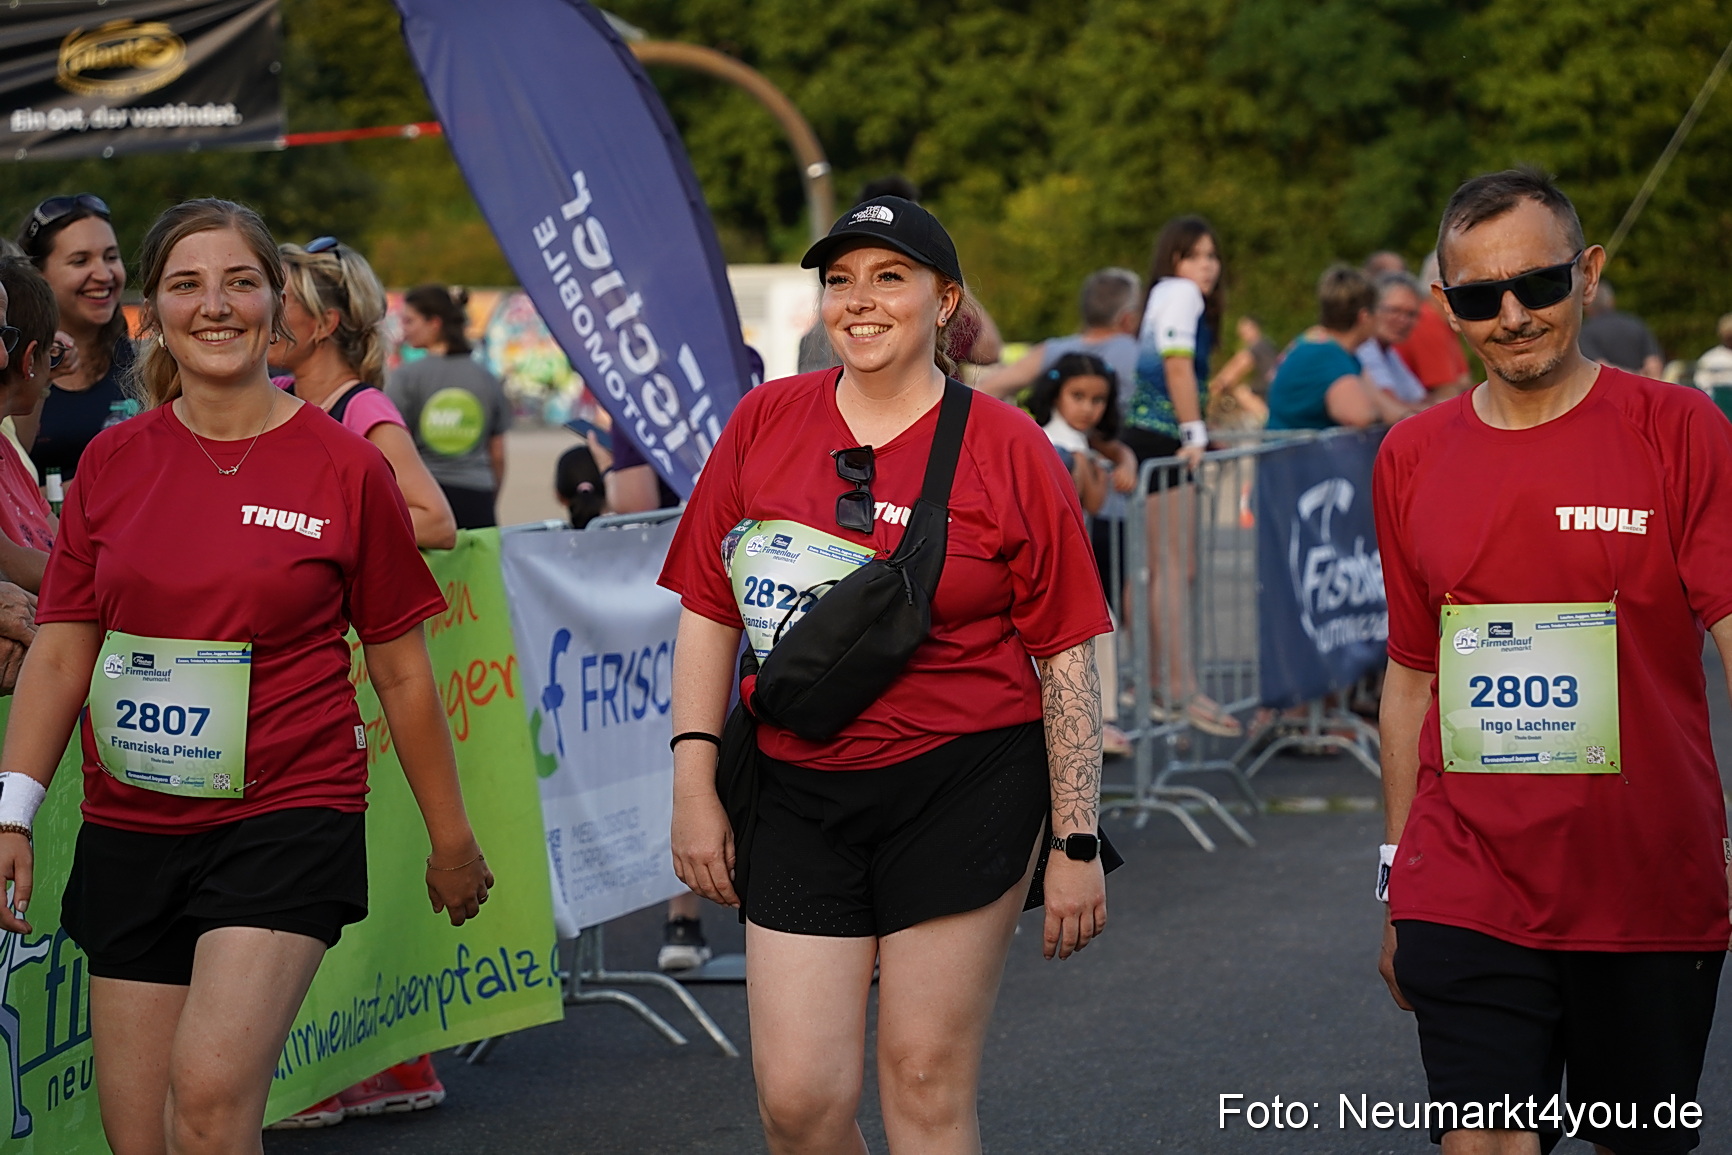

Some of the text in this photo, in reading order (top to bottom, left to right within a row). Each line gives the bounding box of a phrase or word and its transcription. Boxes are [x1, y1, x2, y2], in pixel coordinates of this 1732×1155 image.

[762, 546, 801, 559] Firmenlauf
[743, 576, 819, 613] 2822
[1481, 636, 1533, 647] Firmenlauf
[125, 667, 172, 677] Firmenlauf
[581, 639, 676, 733] FRISC
[440, 654, 518, 742] ger
[1469, 675, 1578, 708] 2803
[116, 699, 210, 737] 2807
[1481, 718, 1577, 734] Ingo Lachner
[111, 736, 222, 760] Franziska Piehler
